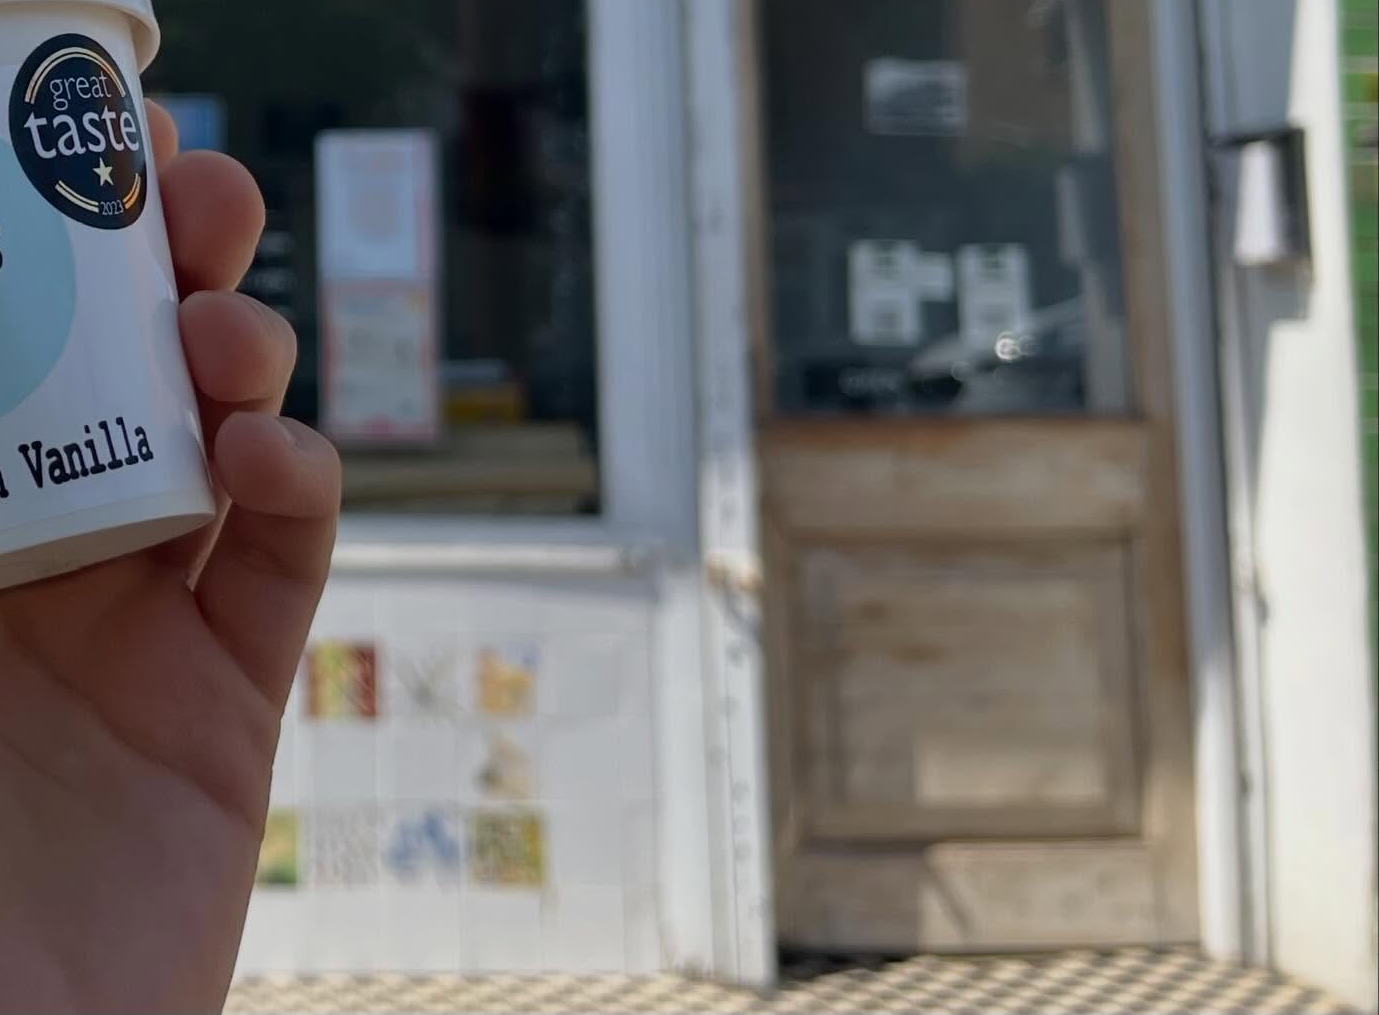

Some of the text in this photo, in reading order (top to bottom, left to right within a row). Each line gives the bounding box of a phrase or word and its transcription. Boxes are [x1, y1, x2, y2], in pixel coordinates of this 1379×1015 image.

[49, 72, 112, 111] great
[24, 105, 140, 160] taste
[99, 200, 124, 216] 2023
[18, 416, 155, 490] Vanilla
